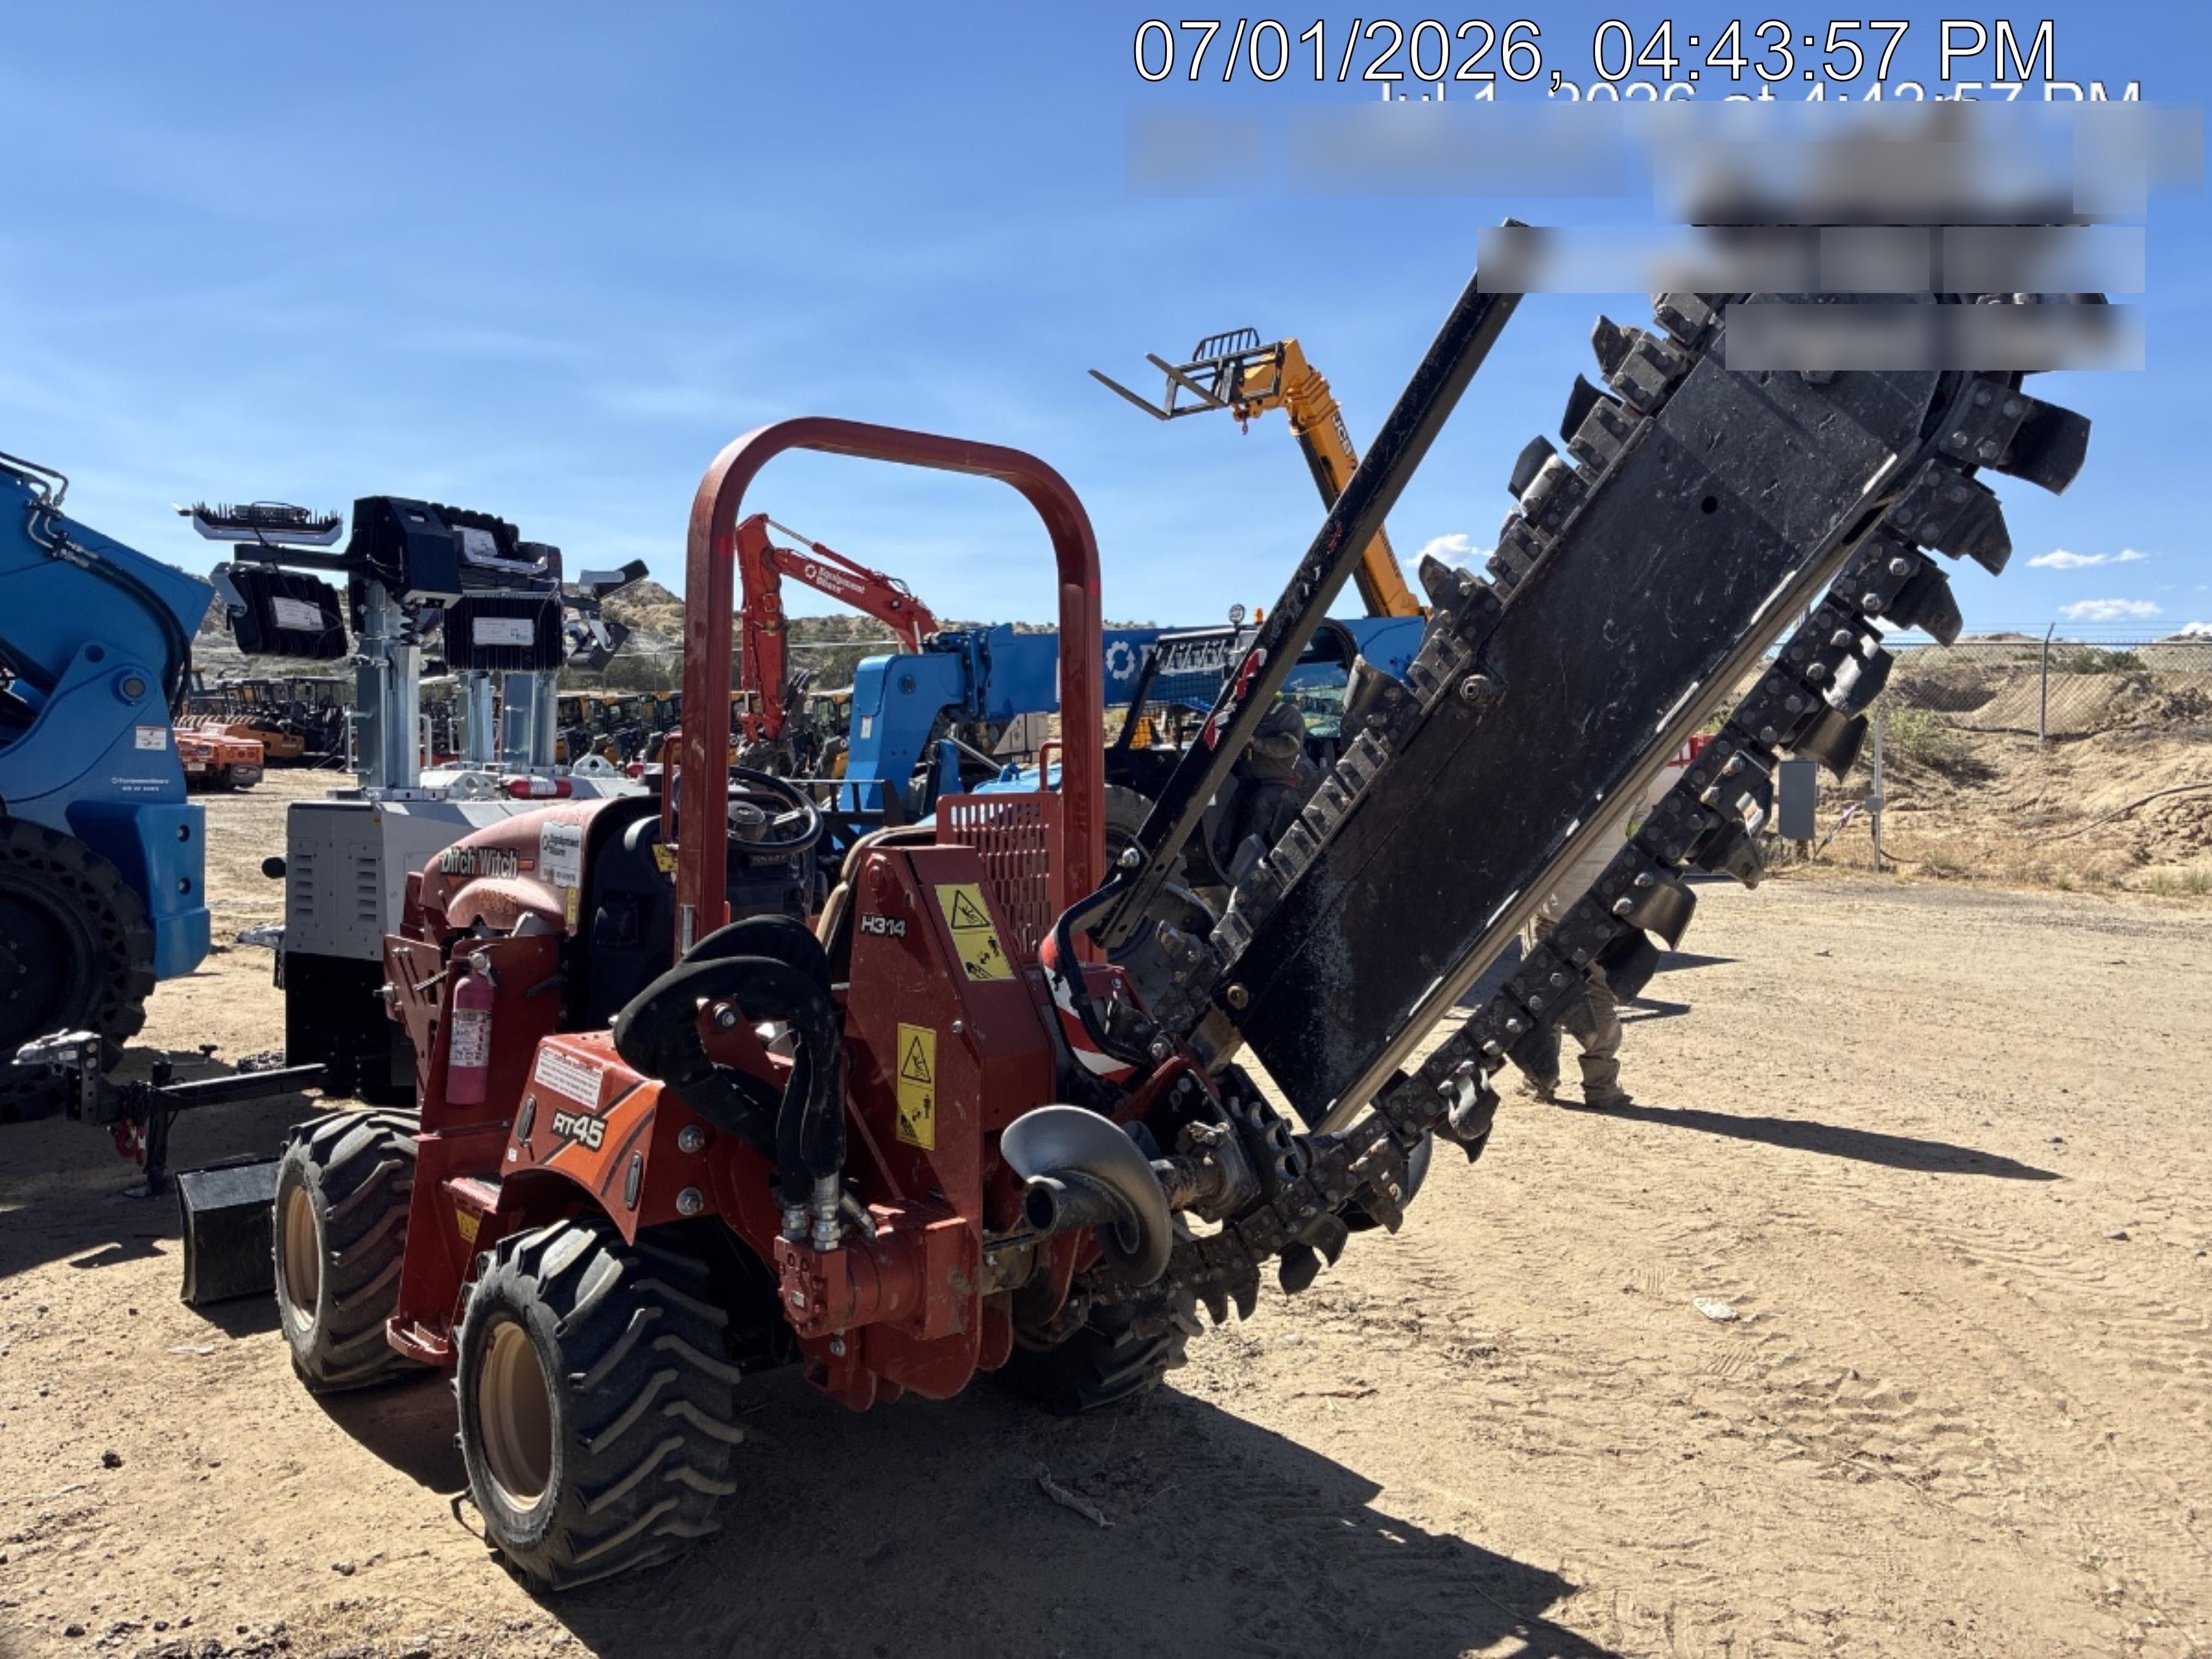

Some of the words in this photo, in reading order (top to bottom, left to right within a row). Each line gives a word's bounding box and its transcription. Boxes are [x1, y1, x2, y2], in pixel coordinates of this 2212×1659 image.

[441, 847, 476, 876] Ditch
[478, 848, 518, 879] Witch
[861, 915, 906, 937] H314
[552, 1112, 606, 1150] RT45
